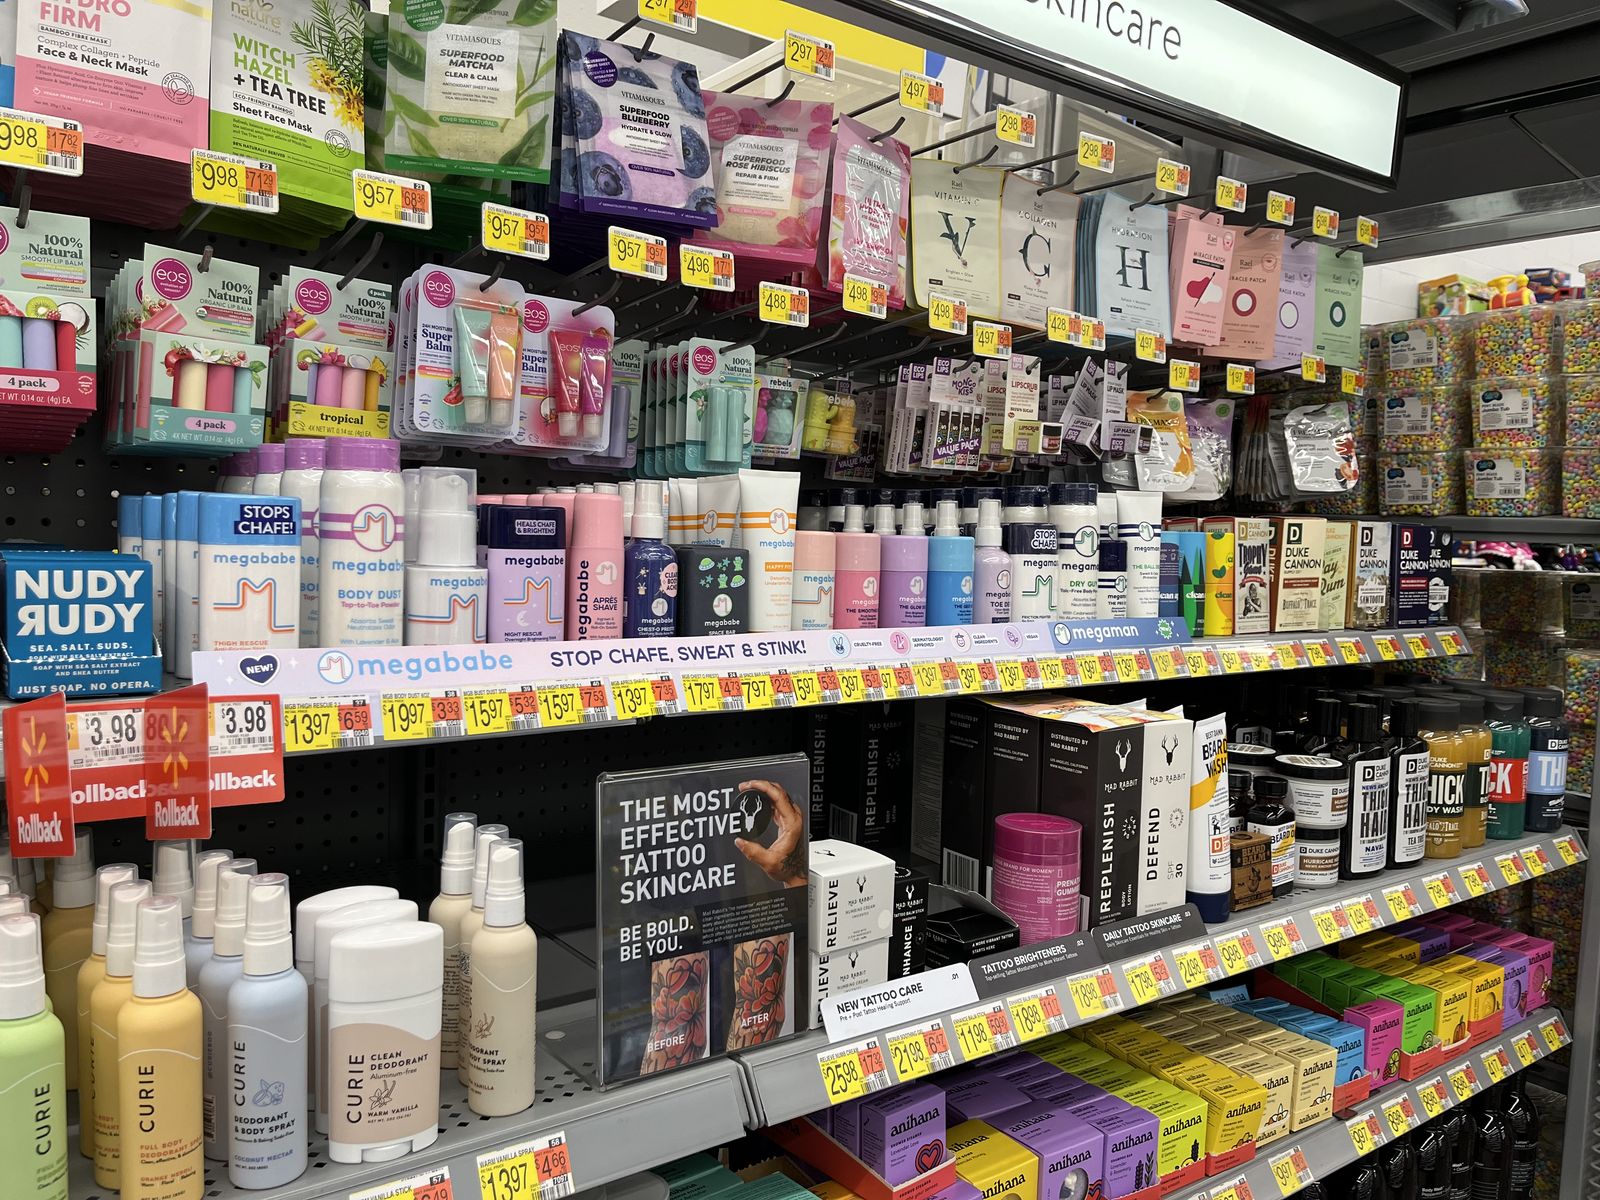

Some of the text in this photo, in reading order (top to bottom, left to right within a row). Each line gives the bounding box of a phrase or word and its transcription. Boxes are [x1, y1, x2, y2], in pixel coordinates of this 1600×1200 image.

[40, 2, 100, 32] FIRM
[231, 1, 280, 28] nature
[41, 26, 70, 36] BAMBOO
[71, 32, 88, 41] FIBRE
[1026, 0, 1181, 60] ncare
[446, 34, 502, 46] VITAMASQUES
[38, 36, 78, 50] Complex
[81, 45, 119, 59] Collagen
[129, 54, 160, 68] Peptide
[233, 32, 296, 69] WITCH
[440, 49, 504, 62] SUPERFOOD
[38, 45, 148, 76] Face & Neck Mask
[449, 59, 494, 71] MATCHA
[234, 52, 292, 86] HAZEL
[234, 74, 327, 115] + TEA TREE
[621, 91, 665, 105] VITAMASQUES
[233, 102, 312, 130] Sheet Face Mask
[620, 105, 670, 121] SUPERFOOD
[622, 113, 670, 129] BLUEBERRY
[726, 161, 790, 174] ROSE HIBISCUS
[733, 154, 785, 166] SUPERFOOD
[44, 234, 83, 249] 100%
[29, 243, 83, 259] Natural
[21, 255, 84, 266] SMOOTH LIP BALM
[155, 269, 188, 284] eos
[221, 280, 253, 294] 100%
[299, 288, 328, 302] eos
[208, 288, 253, 305] Natural
[421, 328, 453, 343] Super
[426, 340, 452, 352] Balm
[8, 378, 46, 389] 4 pack
[770, 378, 792, 388] rebels
[952, 377, 976, 388] MONGO
[1011, 380, 1038, 391] LIPSCRUB
[958, 387, 973, 396] KISS
[320, 413, 364, 426] tropical
[937, 439, 979, 455] VALUE PACK
[244, 505, 290, 519] STOPS
[238, 520, 294, 534] CHAFE!
[516, 520, 535, 528] HEALS
[523, 526, 556, 534] BRIGHTENS
[214, 552, 296, 568] megababe
[1238, 543, 1268, 567] TROPHY
[1285, 547, 1309, 557] DUKE
[505, 554, 564, 568] megababe
[1284, 559, 1321, 569] CANNON
[15, 570, 145, 600] NUDY
[338, 589, 401, 599] BODY DUST
[593, 596, 618, 604] APRÈS
[593, 603, 618, 611] SHAVE
[704, 619, 740, 628] megababe
[1073, 625, 1138, 644] megaman
[30, 642, 133, 651] SEA. SALT. SUDS.
[550, 640, 807, 668] STOP CHAFE, SWEAT & STINK!
[246, 663, 274, 675] NEW!
[359, 650, 513, 681] megababe
[17, 685, 47, 694] JUST
[50, 684, 86, 693] SOAP.
[111, 681, 155, 690] OPERA.
[1202, 738, 1228, 761] BEARD
[1205, 762, 1227, 779] WASH
[1105, 778, 1138, 793] MAD RABBIT
[155, 797, 199, 827] Rollback
[620, 788, 734, 822] THE MOST
[17, 812, 63, 844] Rollback
[621, 811, 741, 850] EFFECTIVE
[1146, 807, 1160, 881] DEFEND
[620, 843, 706, 877] TATTOO
[1100, 803, 1115, 913] REPLENISH
[1175, 863, 1183, 878] 30
[620, 863, 736, 904] SKINCARE
[848, 896, 874, 906] MAD RABBIT
[827, 879, 839, 948] RELIEVE
[621, 925, 641, 943] BE
[647, 916, 694, 938] BOLD.
[1103, 913, 1182, 942] DAILY TATTOO SKINCARE
[621, 936, 683, 962] BE YOU.
[981, 944, 1067, 975] TATTOO BRIGHTENERS
[837, 982, 924, 1014] NEW TATTOO CARE
[1406, 1000, 1433, 1019] anihana
[740, 1013, 769, 1029] AFTER
[1372, 1017, 1401, 1034] anihana
[647, 1034, 685, 1054] BEFORE
[370, 1050, 402, 1061] CLEAN
[370, 1053, 428, 1071] DEODORANT
[234, 1040, 246, 1106] CURIE
[369, 1067, 417, 1080] Aluminum-free
[346, 1054, 365, 1123] CURIE
[138, 1064, 156, 1133] CURIE
[234, 1112, 288, 1124] DEODORANT
[367, 1104, 418, 1117] WARM VANILLA
[1226, 1101, 1261, 1119] anihana
[34, 1083, 52, 1156] CURIE
[240, 1126, 265, 1135] BODY
[268, 1118, 296, 1133] SPRAY
[890, 1106, 940, 1138] anihana
[1163, 1114, 1202, 1137] anihana
[1111, 1130, 1154, 1154] anihana
[1048, 1149, 1092, 1174] anihana
